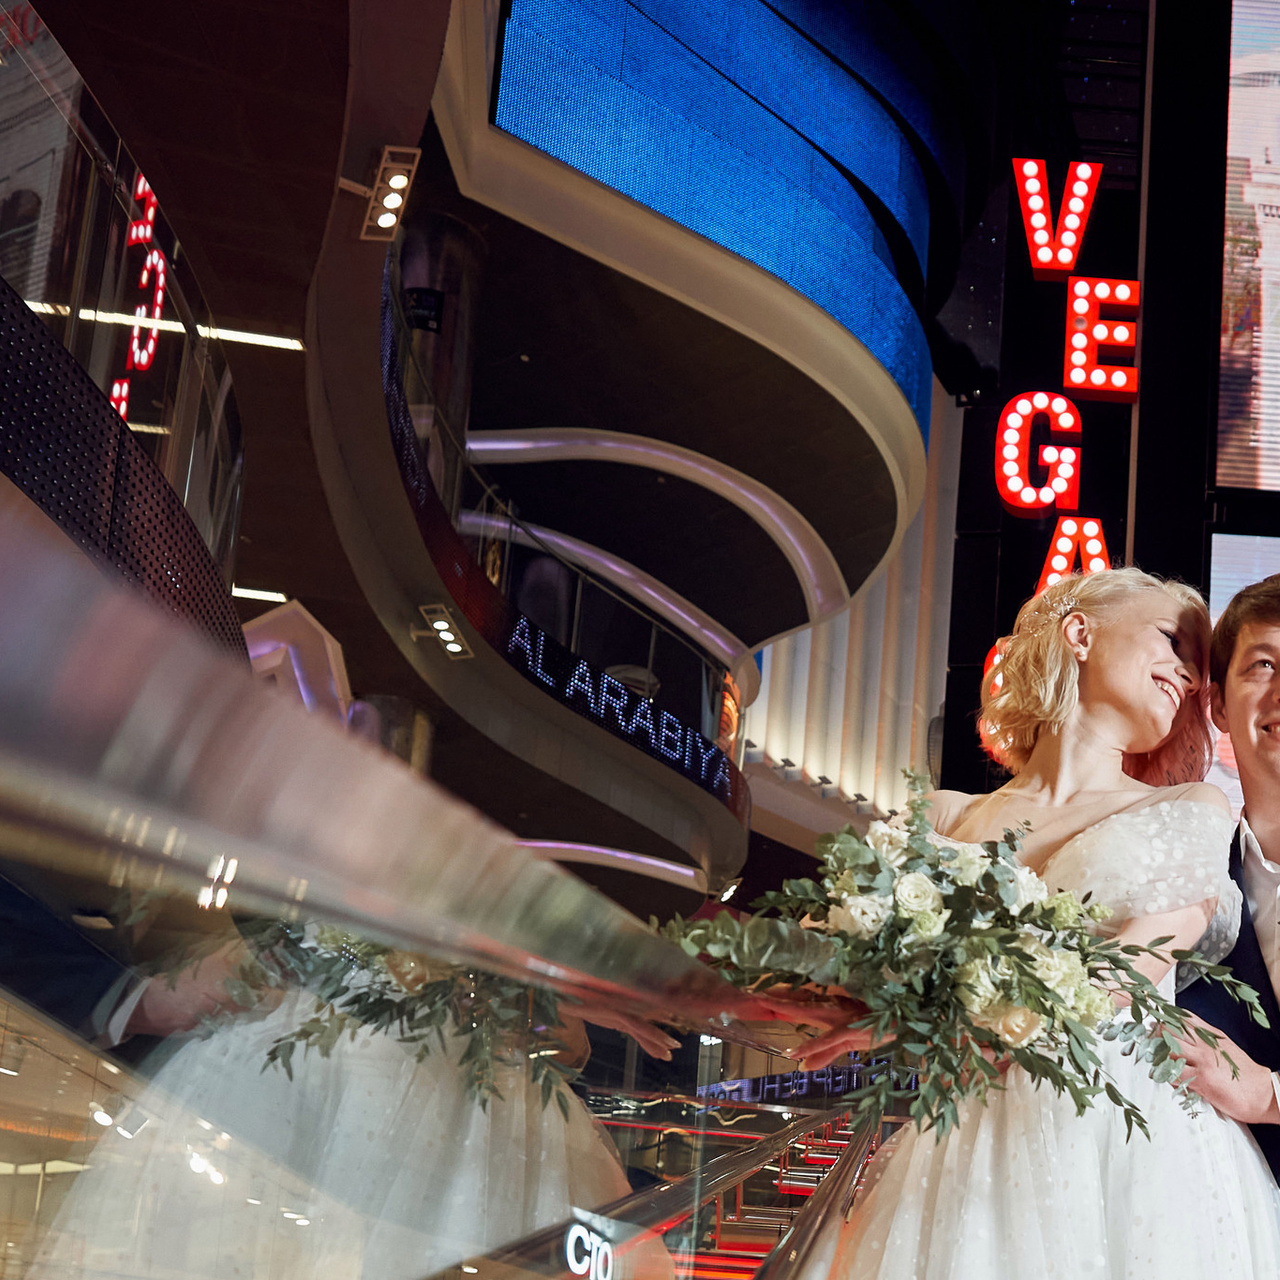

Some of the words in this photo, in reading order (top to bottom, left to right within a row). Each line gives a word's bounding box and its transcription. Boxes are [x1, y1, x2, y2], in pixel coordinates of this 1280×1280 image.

[980, 157, 1140, 770] VEGA
[508, 614, 556, 688] AL
[565, 659, 732, 797] ARABIYA
